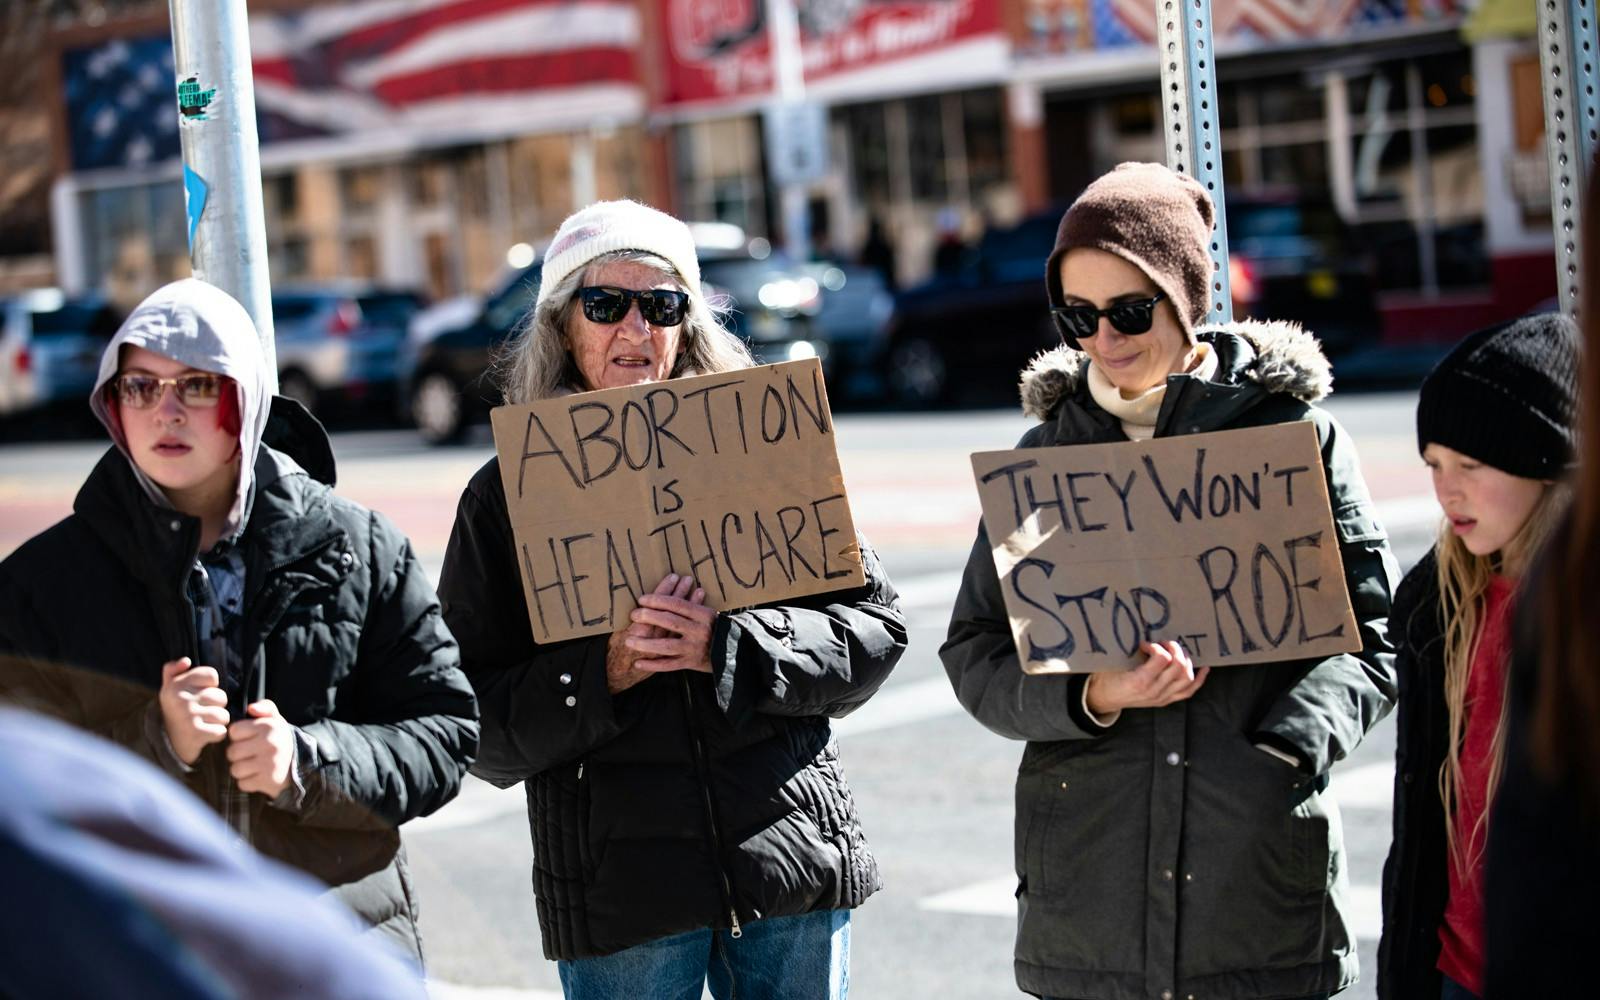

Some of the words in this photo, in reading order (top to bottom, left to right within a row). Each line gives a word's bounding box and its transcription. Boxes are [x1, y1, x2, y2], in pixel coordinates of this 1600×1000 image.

[518, 368, 830, 498] ABORTION
[652, 479, 684, 515] IS
[981, 459, 1136, 534] THEY
[1141, 448, 1309, 523] WON'T
[522, 494, 853, 639] HEALTHCARE
[1011, 557, 1170, 661] STOP
[1176, 633, 1207, 657] AT
[1197, 530, 1344, 657] ROE
